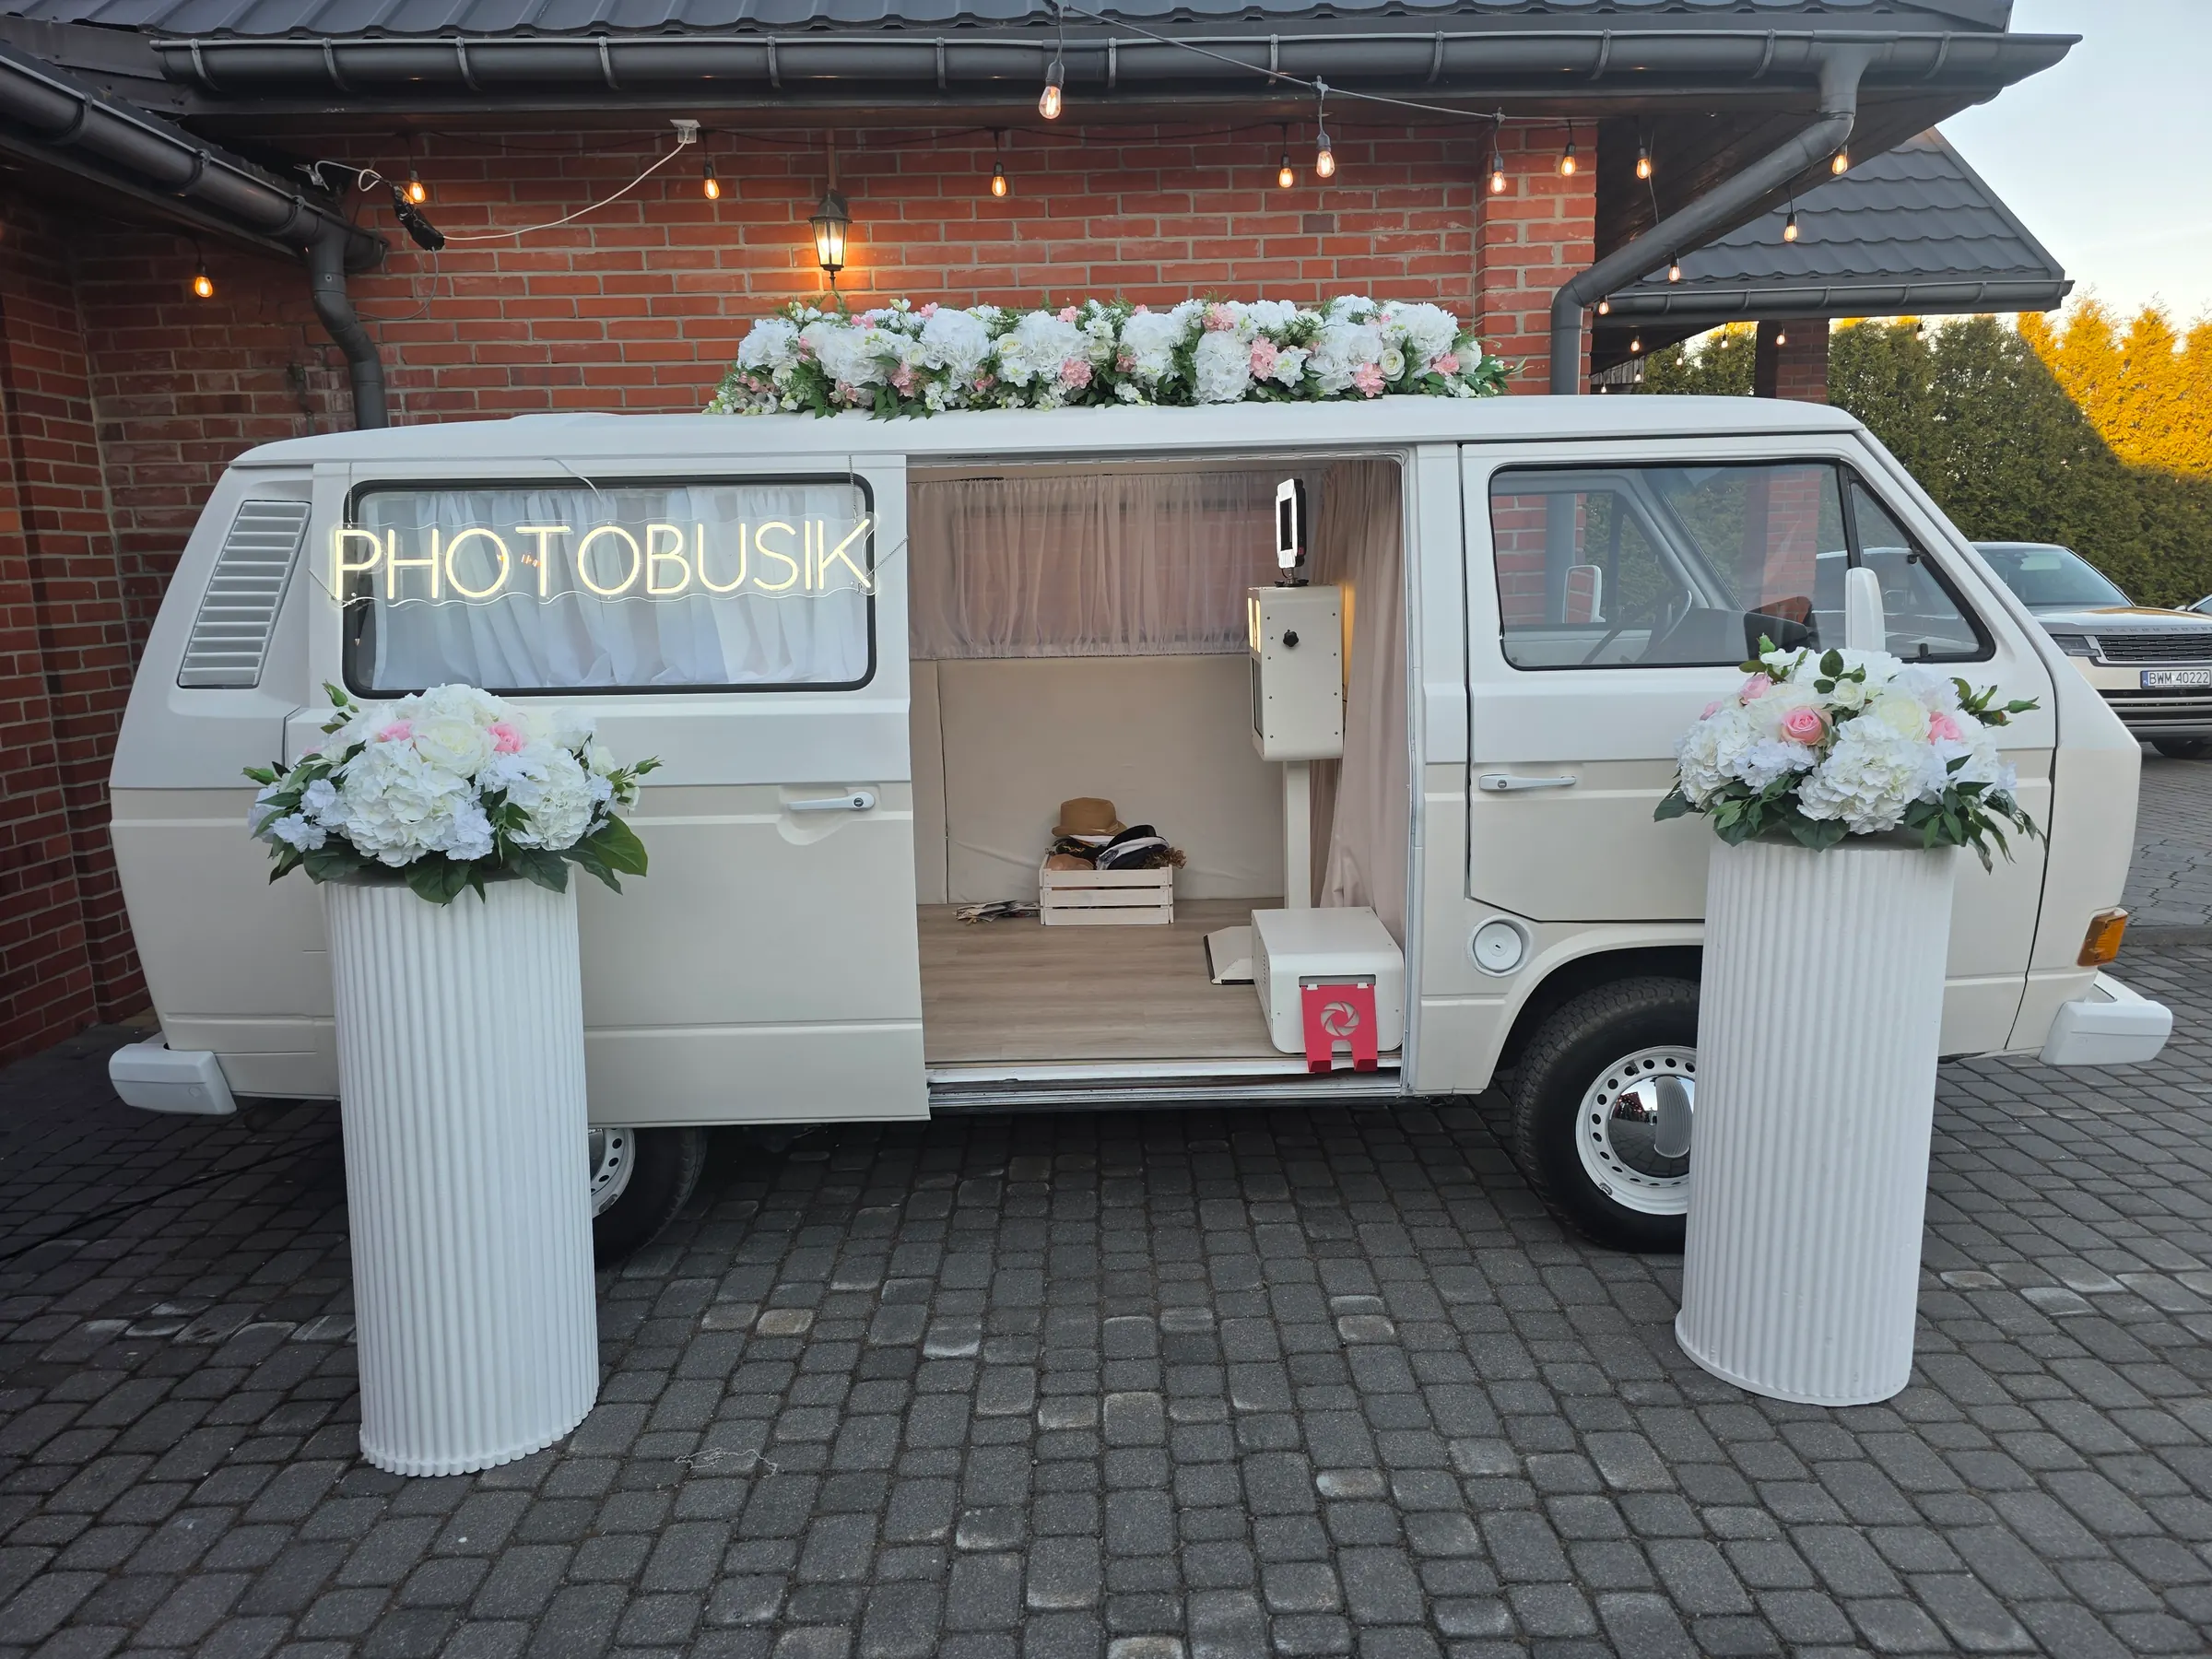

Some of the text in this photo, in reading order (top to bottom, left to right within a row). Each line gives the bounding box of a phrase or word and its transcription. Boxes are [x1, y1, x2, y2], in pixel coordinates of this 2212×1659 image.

[334, 518, 872, 602] PHOTOBUSIK
[2148, 672, 2172, 685] BWM
[2175, 671, 2209, 684] 40222
